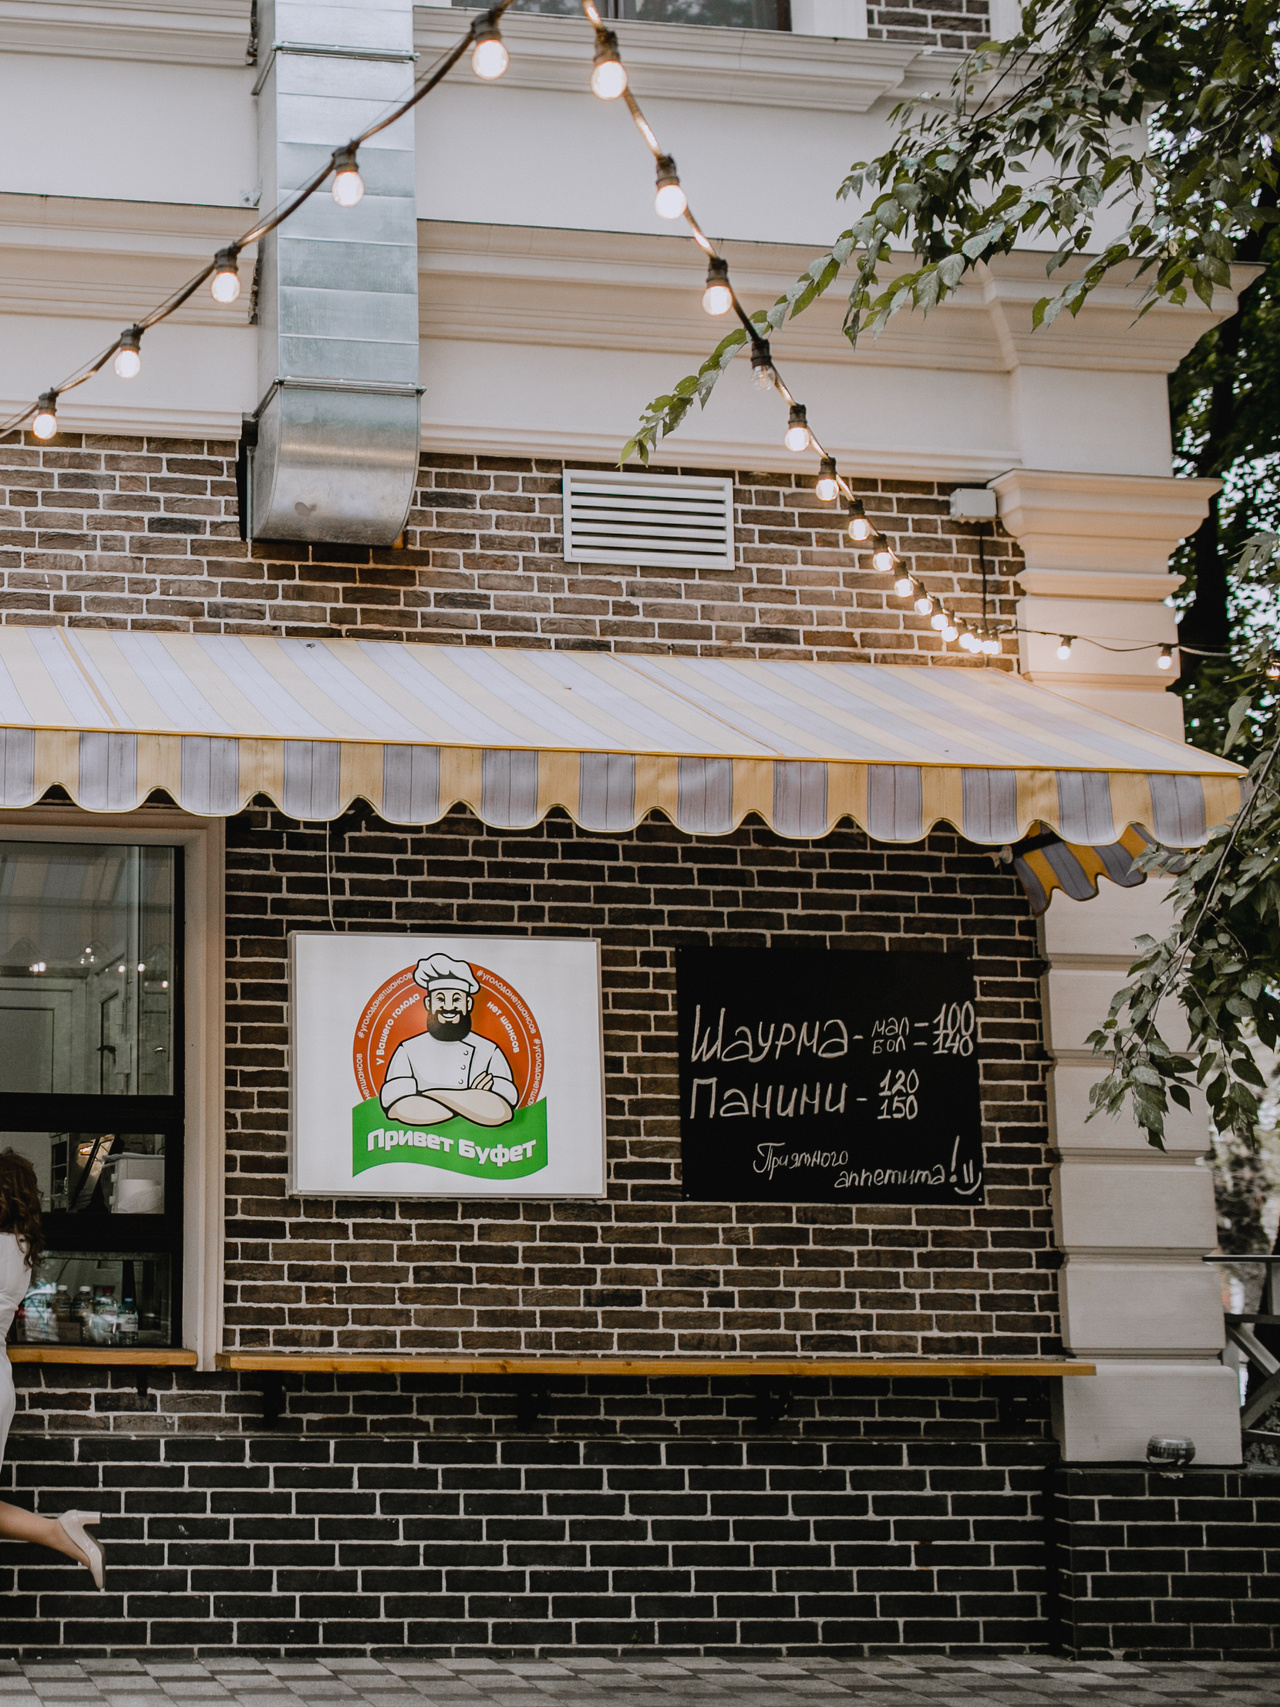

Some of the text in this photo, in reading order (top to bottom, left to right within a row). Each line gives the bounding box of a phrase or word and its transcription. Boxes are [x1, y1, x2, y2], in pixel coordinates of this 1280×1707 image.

[375, 1018, 395, 1055] Вашего
[391, 992, 421, 1019] голода
[486, 1001, 520, 1054] нет шансов
[932, 1033, 974, 1056] 140
[878, 1068, 920, 1096] 120
[877, 1094, 919, 1120] 150
[367, 1128, 537, 1168] Привет Буфет
[753, 1141, 849, 1181] Приятного
